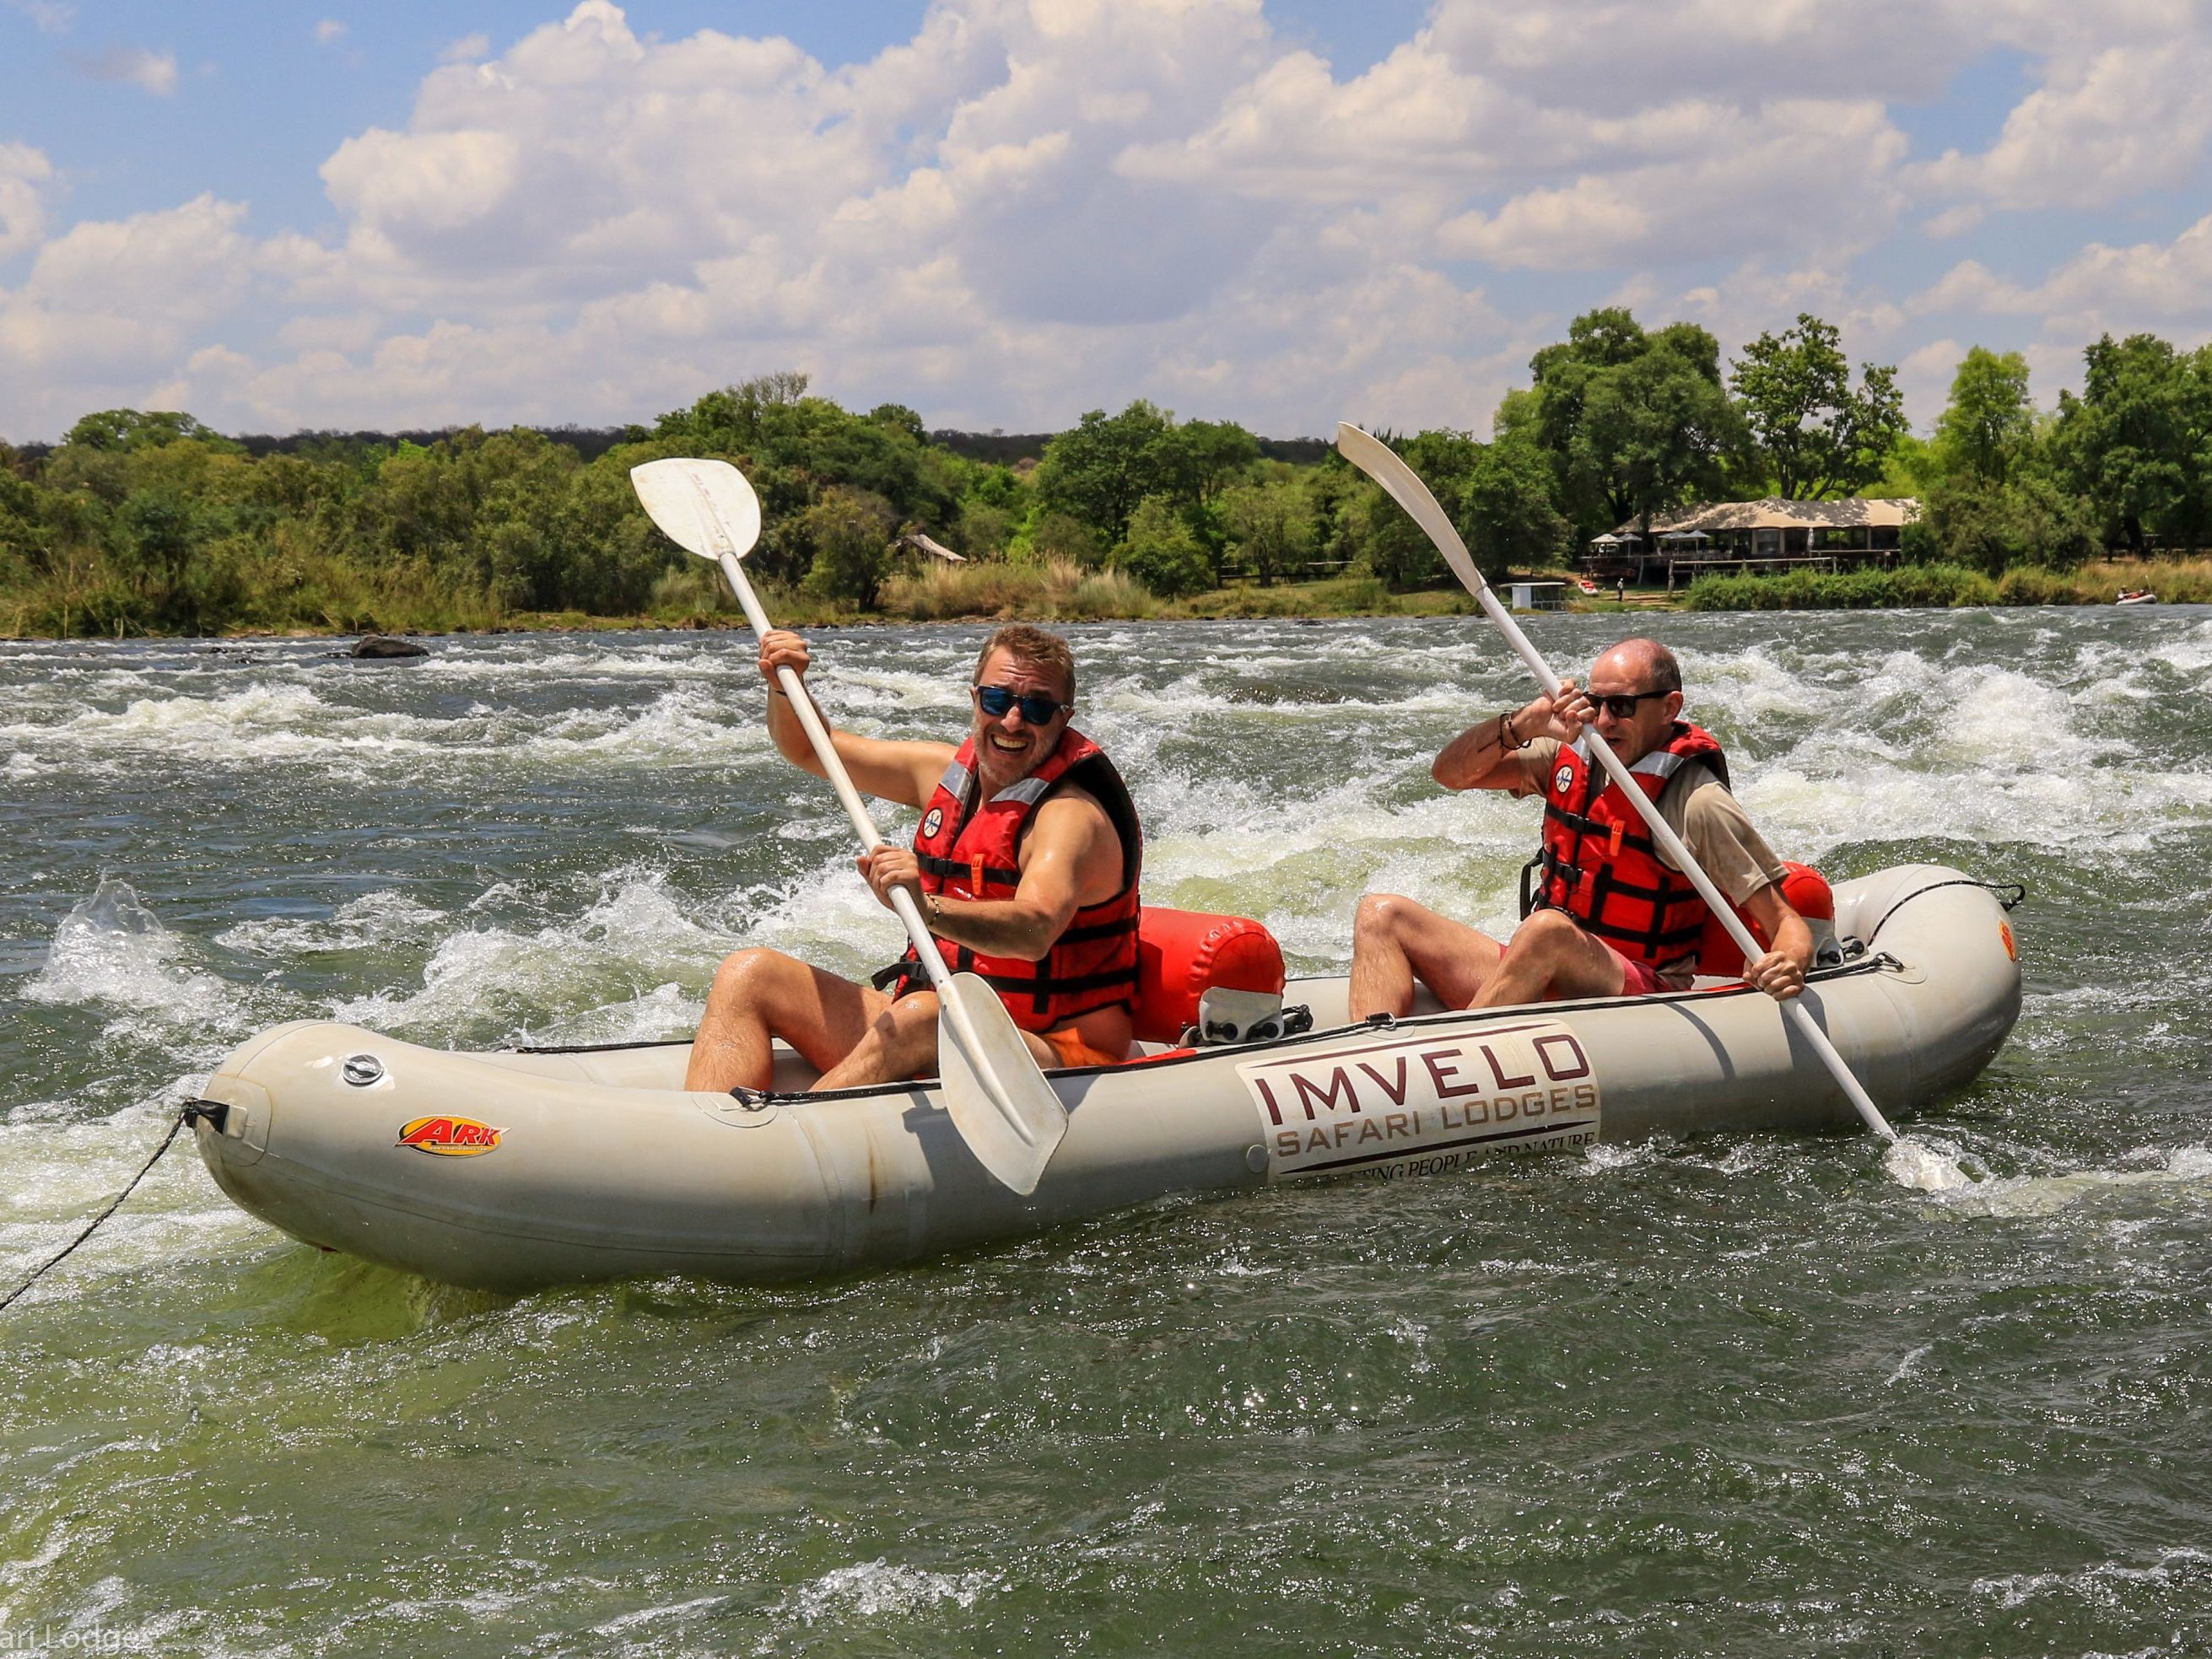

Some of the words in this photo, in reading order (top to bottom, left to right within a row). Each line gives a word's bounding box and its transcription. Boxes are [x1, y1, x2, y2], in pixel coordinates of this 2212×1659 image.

[1254, 1034, 1590, 1126] IMVELO
[1276, 1110, 1422, 1158] SAFARI
[1441, 1084, 1597, 1129] LODGES
